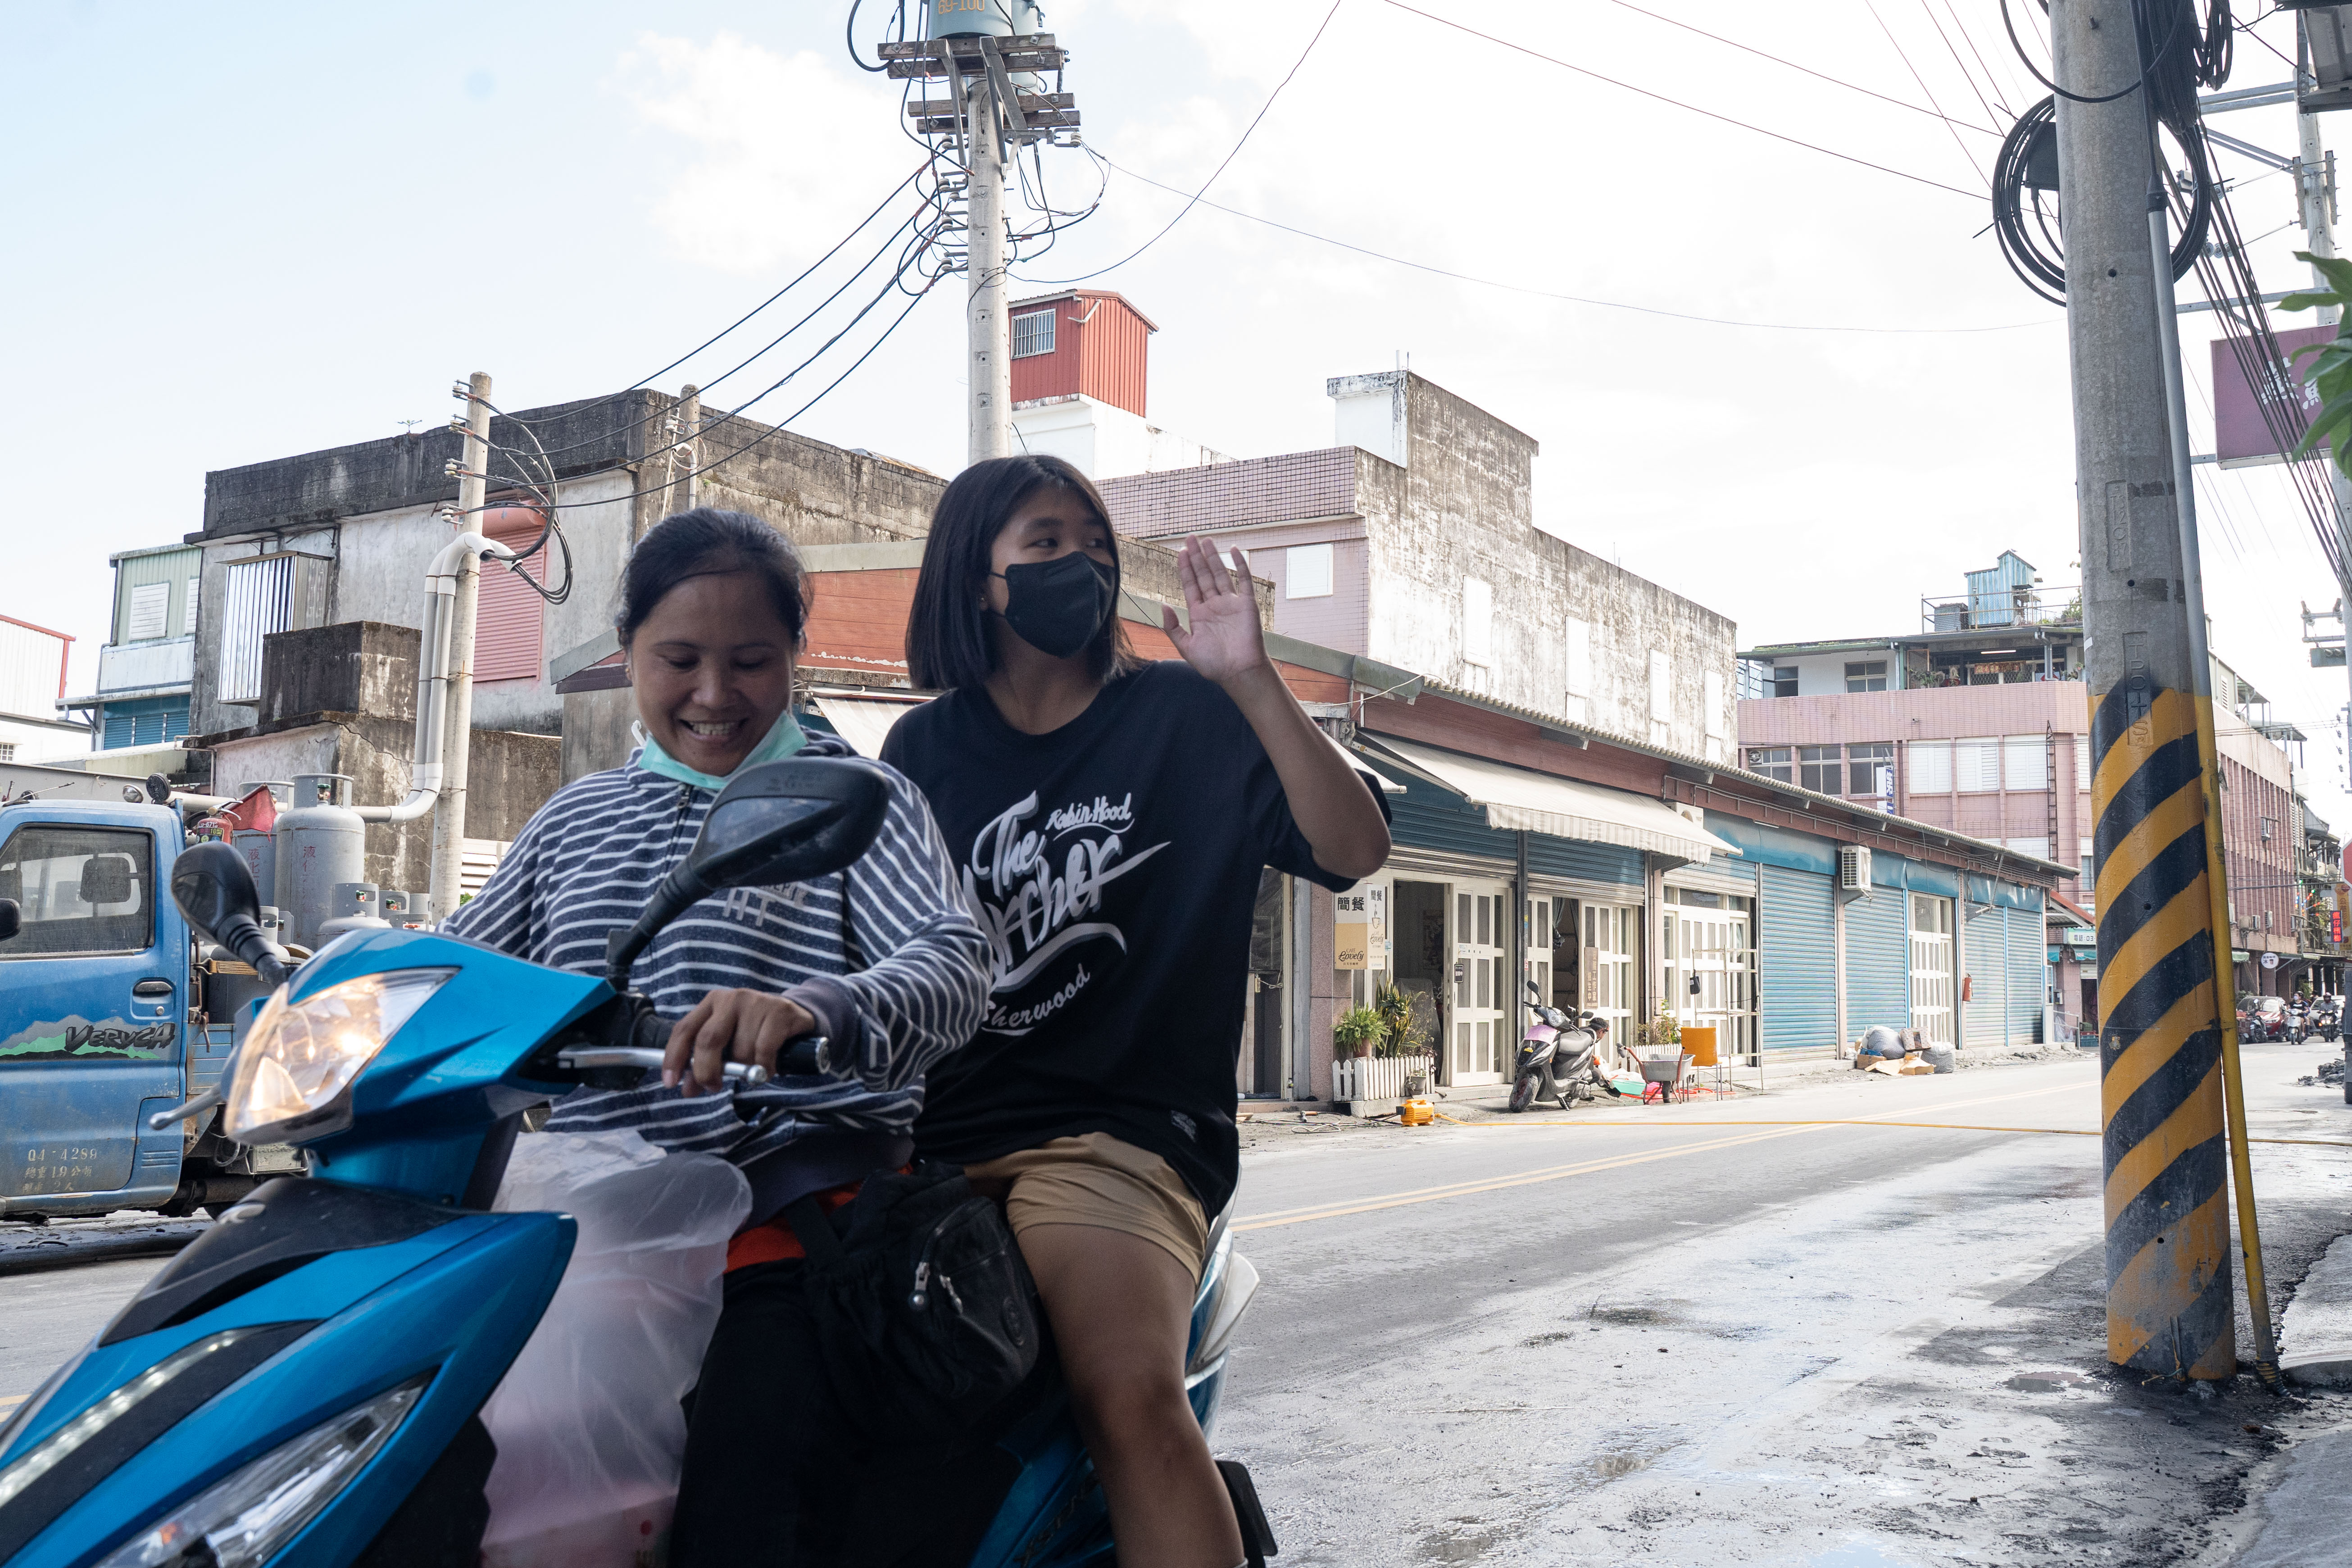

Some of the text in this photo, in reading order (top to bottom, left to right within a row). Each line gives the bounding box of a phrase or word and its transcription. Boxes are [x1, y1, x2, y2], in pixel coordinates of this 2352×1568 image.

[1045, 792, 1132, 830] Robin Hood
[972, 790, 1046, 901] The
[1371, 890, 1382, 901] 簡餐
[1338, 897, 1364, 911] 簡餐
[1370, 933, 1384, 944] Lovely
[1338, 951, 1364, 962] Lovely
